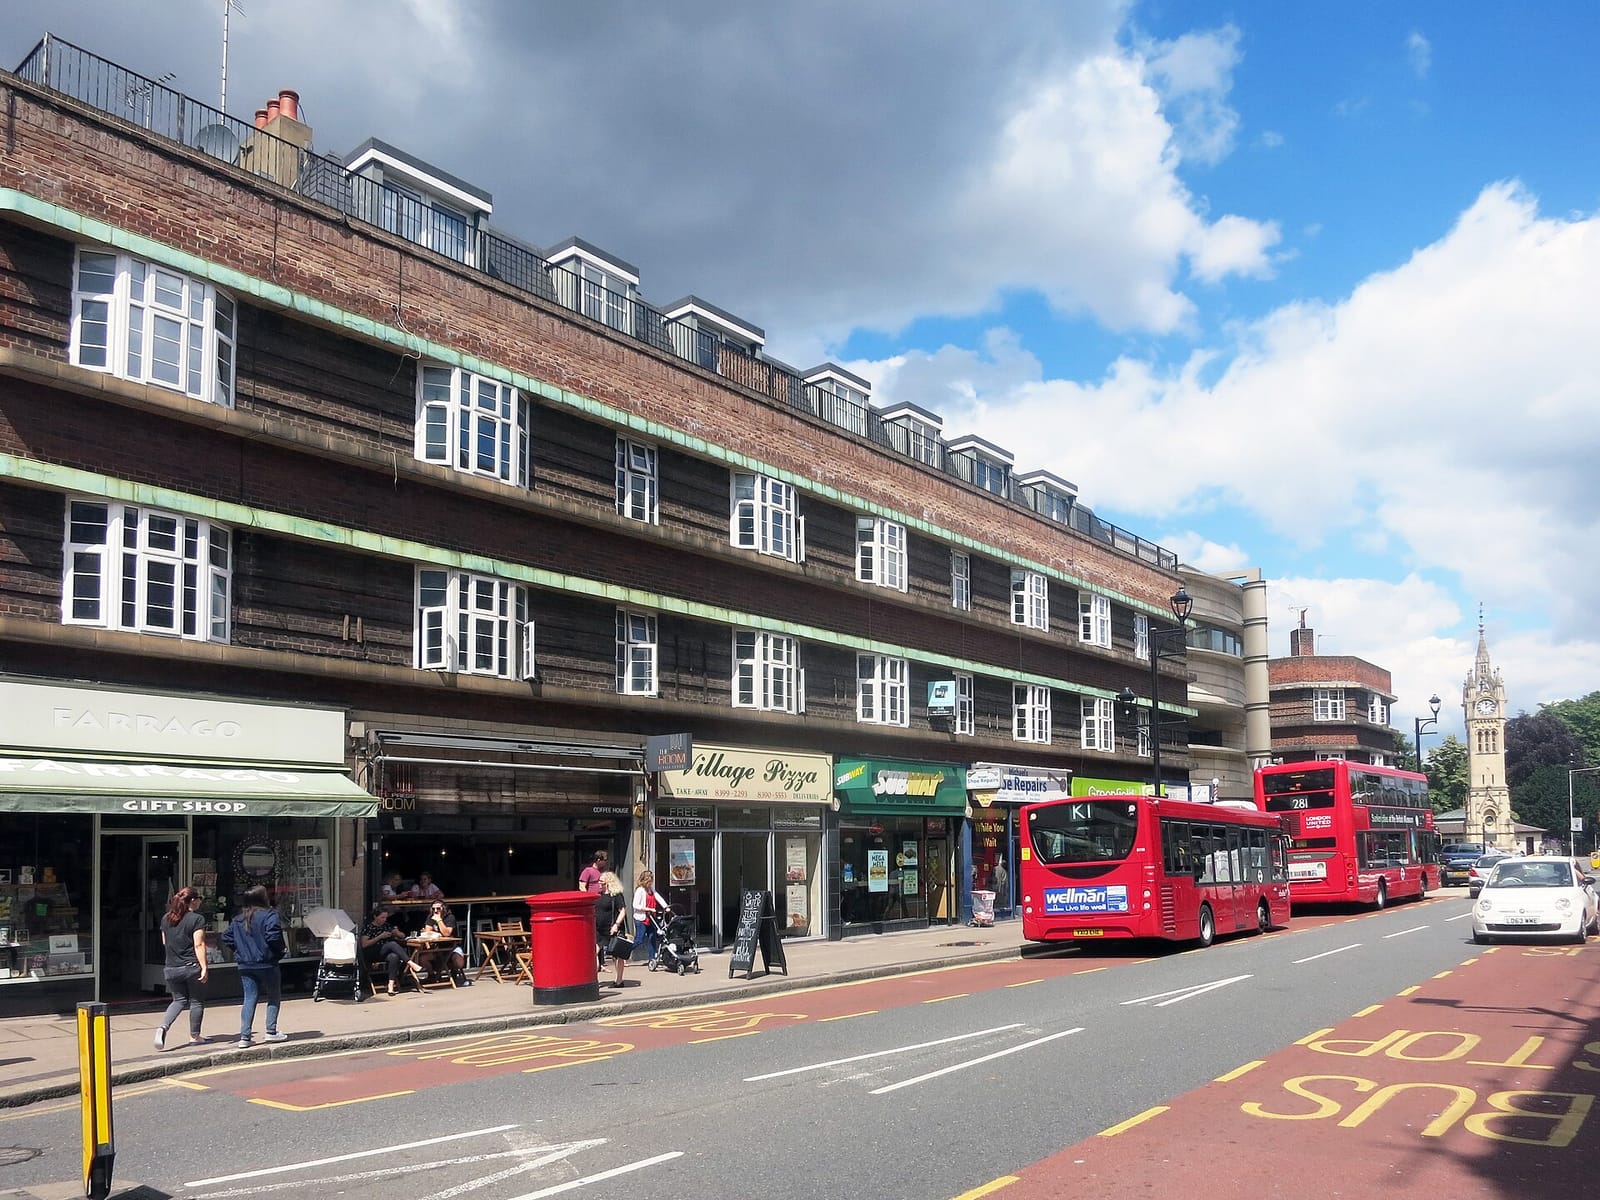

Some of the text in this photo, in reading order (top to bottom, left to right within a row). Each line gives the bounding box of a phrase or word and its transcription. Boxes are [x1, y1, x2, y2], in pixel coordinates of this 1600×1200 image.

[53, 707, 242, 737] FARRAGO
[657, 753, 686, 765] ROOM
[683, 753, 817, 792] Village Pizza
[836, 764, 866, 786] SUBWAY
[872, 769, 945, 797] SUBWAY
[1014, 777, 1047, 795] Repairs
[122, 800, 247, 813] GIFT SHOP
[593, 806, 611, 814] COFFEE
[1292, 798, 1308, 809] 281
[669, 807, 698, 816] FREE
[1072, 805, 1091, 819] K1
[658, 817, 709, 828] DELIVERY
[975, 822, 1005, 833] While You
[983, 837, 997, 848] Wait
[871, 854, 885, 862] MEGA
[1046, 887, 1106, 904] wellman
[600, 1009, 808, 1033] BUS
[386, 1034, 636, 1067] STOP
[1241, 1074, 1596, 1148] BUS
